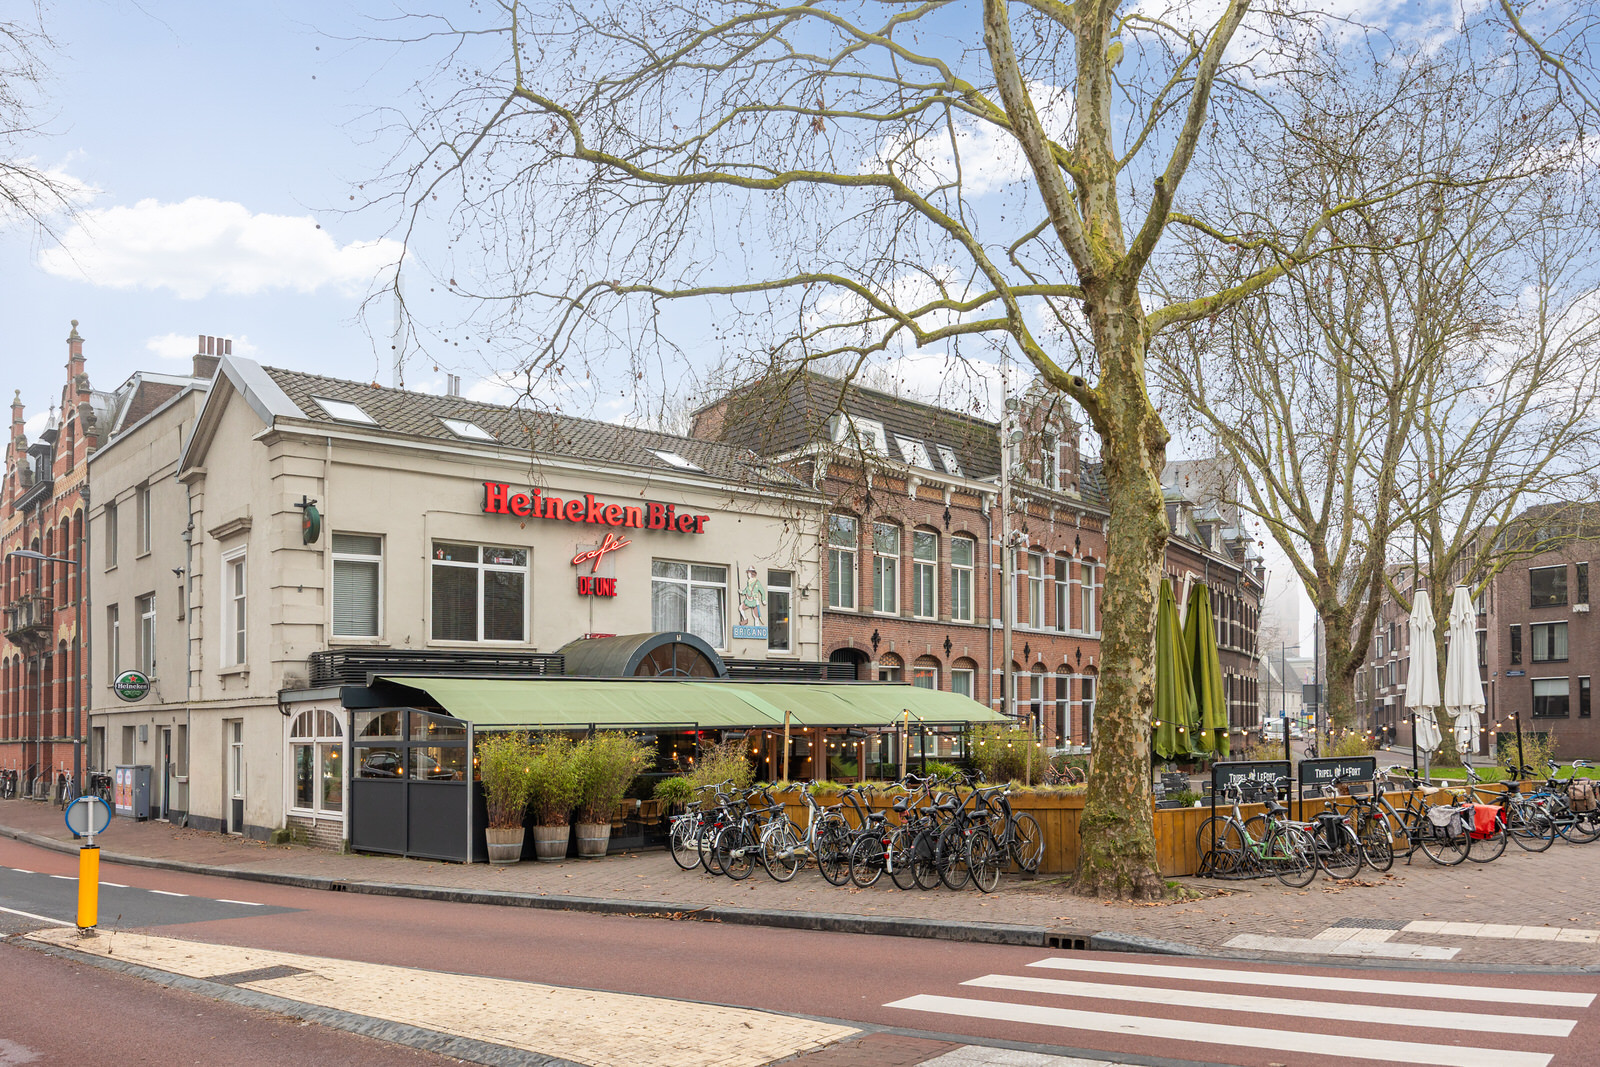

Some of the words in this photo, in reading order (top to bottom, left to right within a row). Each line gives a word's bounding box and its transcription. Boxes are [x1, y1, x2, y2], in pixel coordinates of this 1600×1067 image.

[483, 482, 643, 528] Heineken
[645, 502, 710, 534] Bier
[571, 533, 632, 573] café
[578, 576, 593, 595] DE
[594, 577, 617, 597] UNIE
[734, 627, 767, 637] BRIGAND
